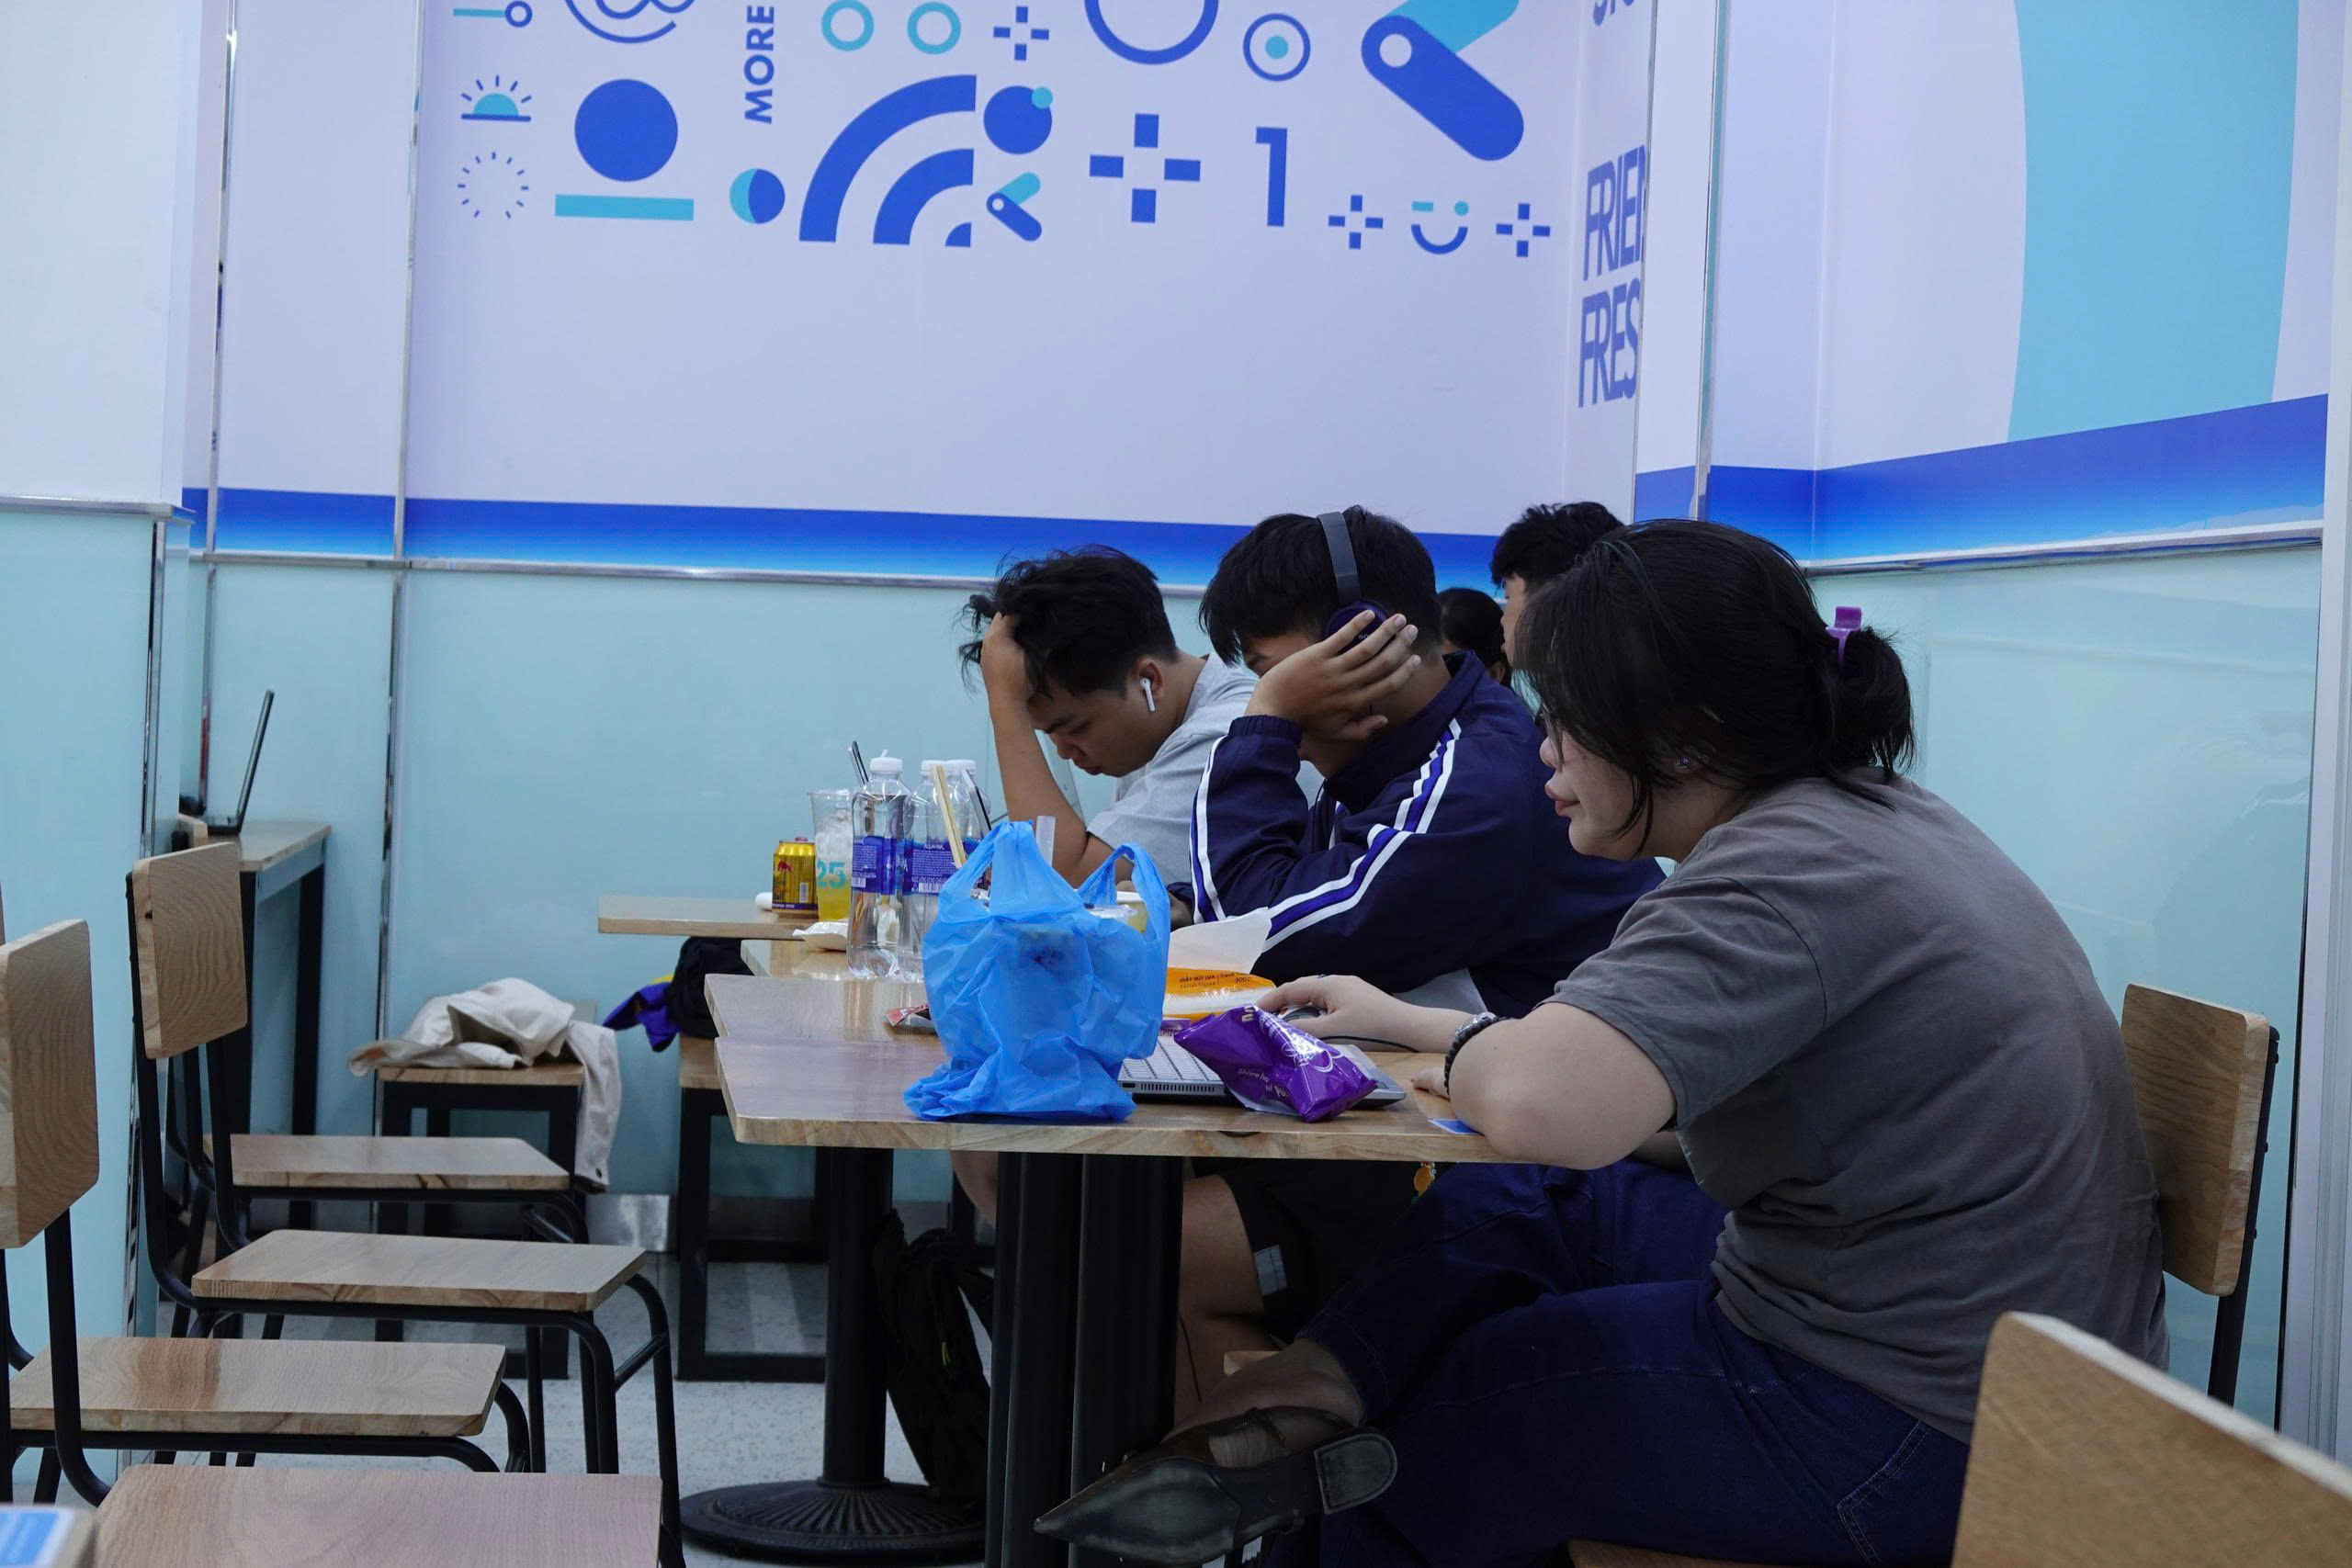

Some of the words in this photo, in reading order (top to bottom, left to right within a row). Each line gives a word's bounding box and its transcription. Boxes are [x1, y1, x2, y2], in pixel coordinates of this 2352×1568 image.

[743, 5, 775, 125] MORE
[1578, 277, 1641, 409] FRES
[817, 859, 846, 889] 25
